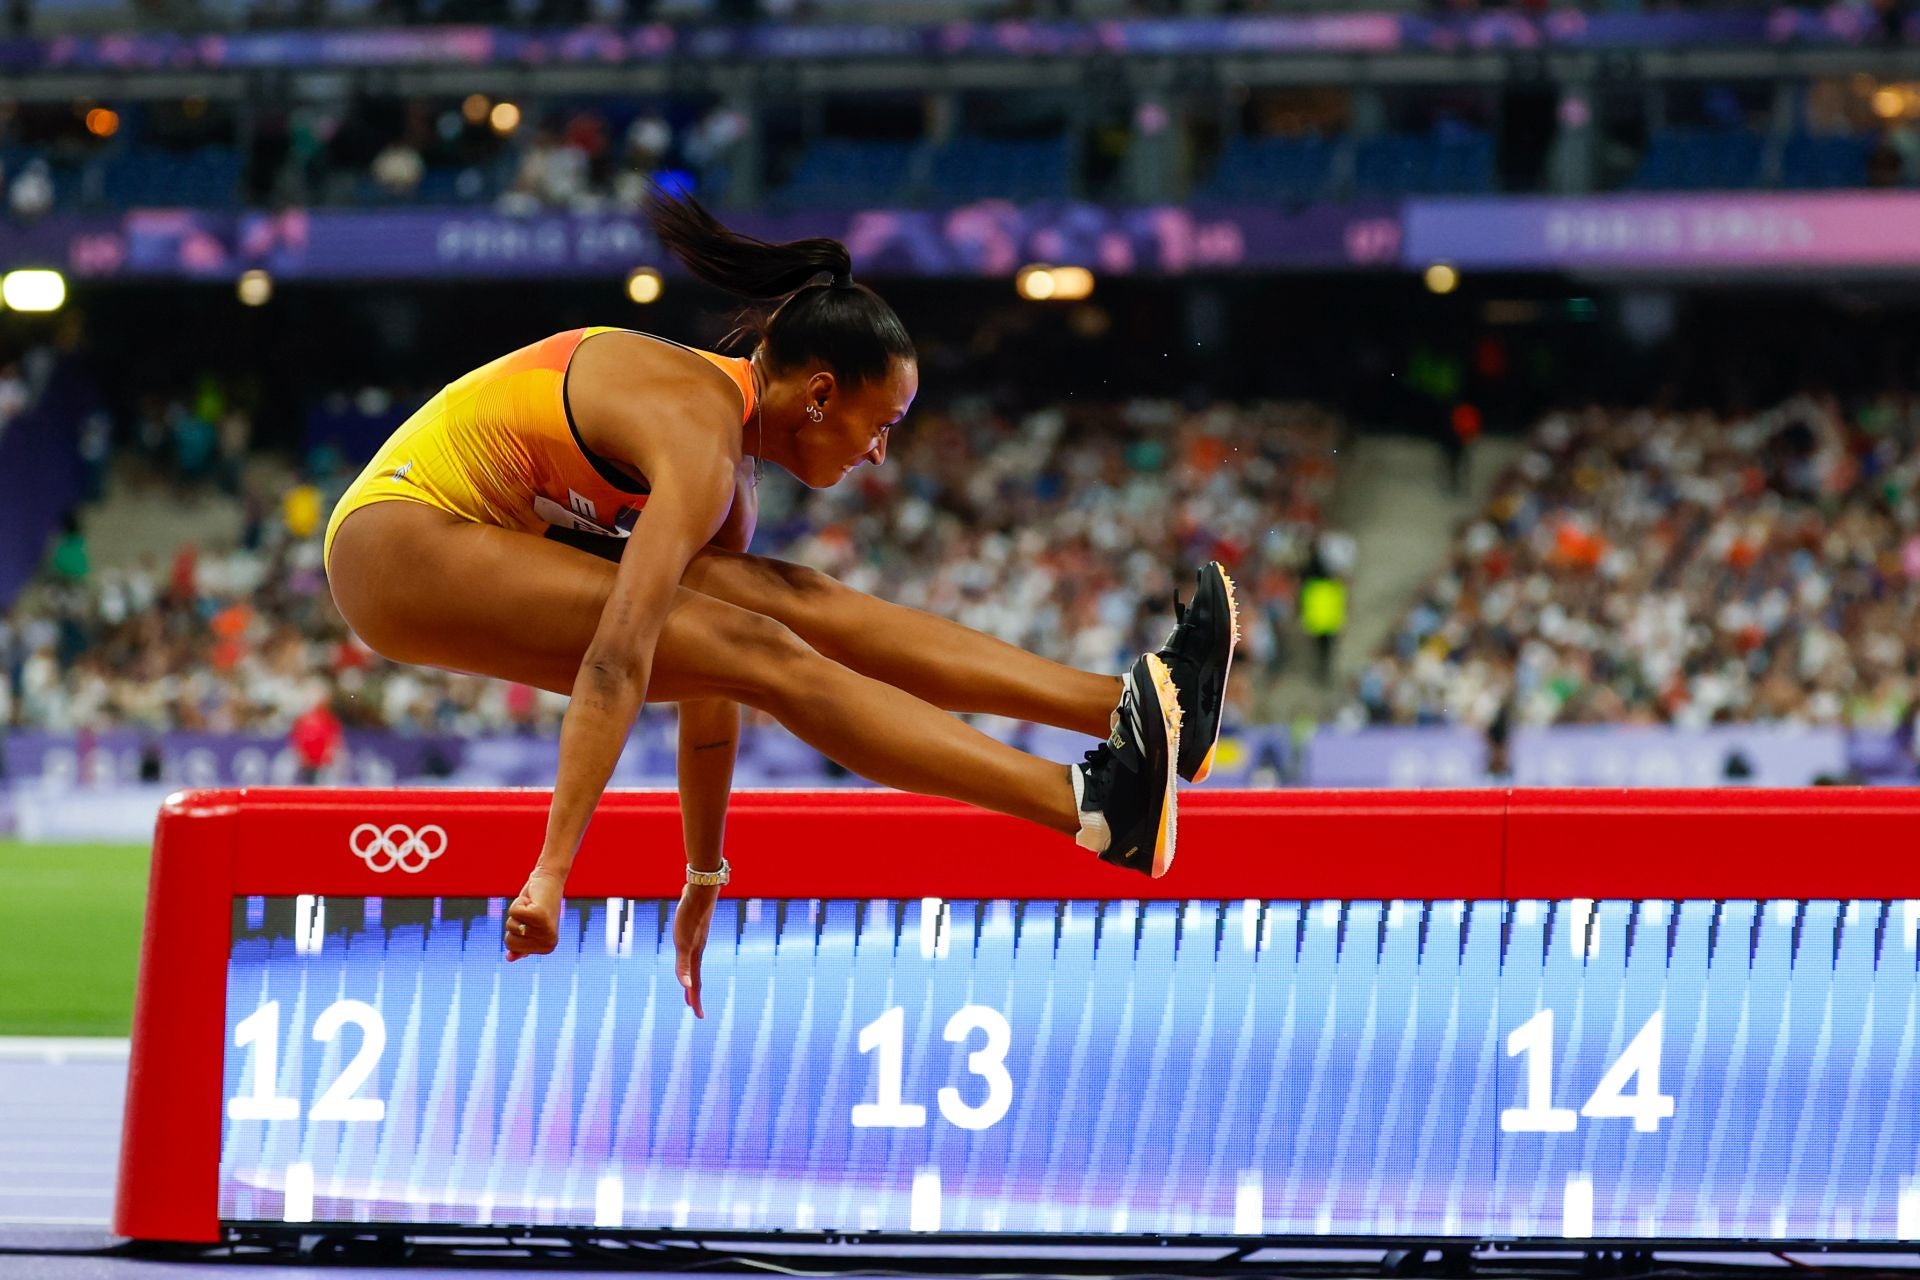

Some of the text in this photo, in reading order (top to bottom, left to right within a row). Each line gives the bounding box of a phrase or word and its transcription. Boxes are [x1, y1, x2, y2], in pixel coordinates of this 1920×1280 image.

[228, 1000, 386, 1121] 12
[852, 1005, 1013, 1129] 13
[1501, 1009, 1674, 1132] 14
